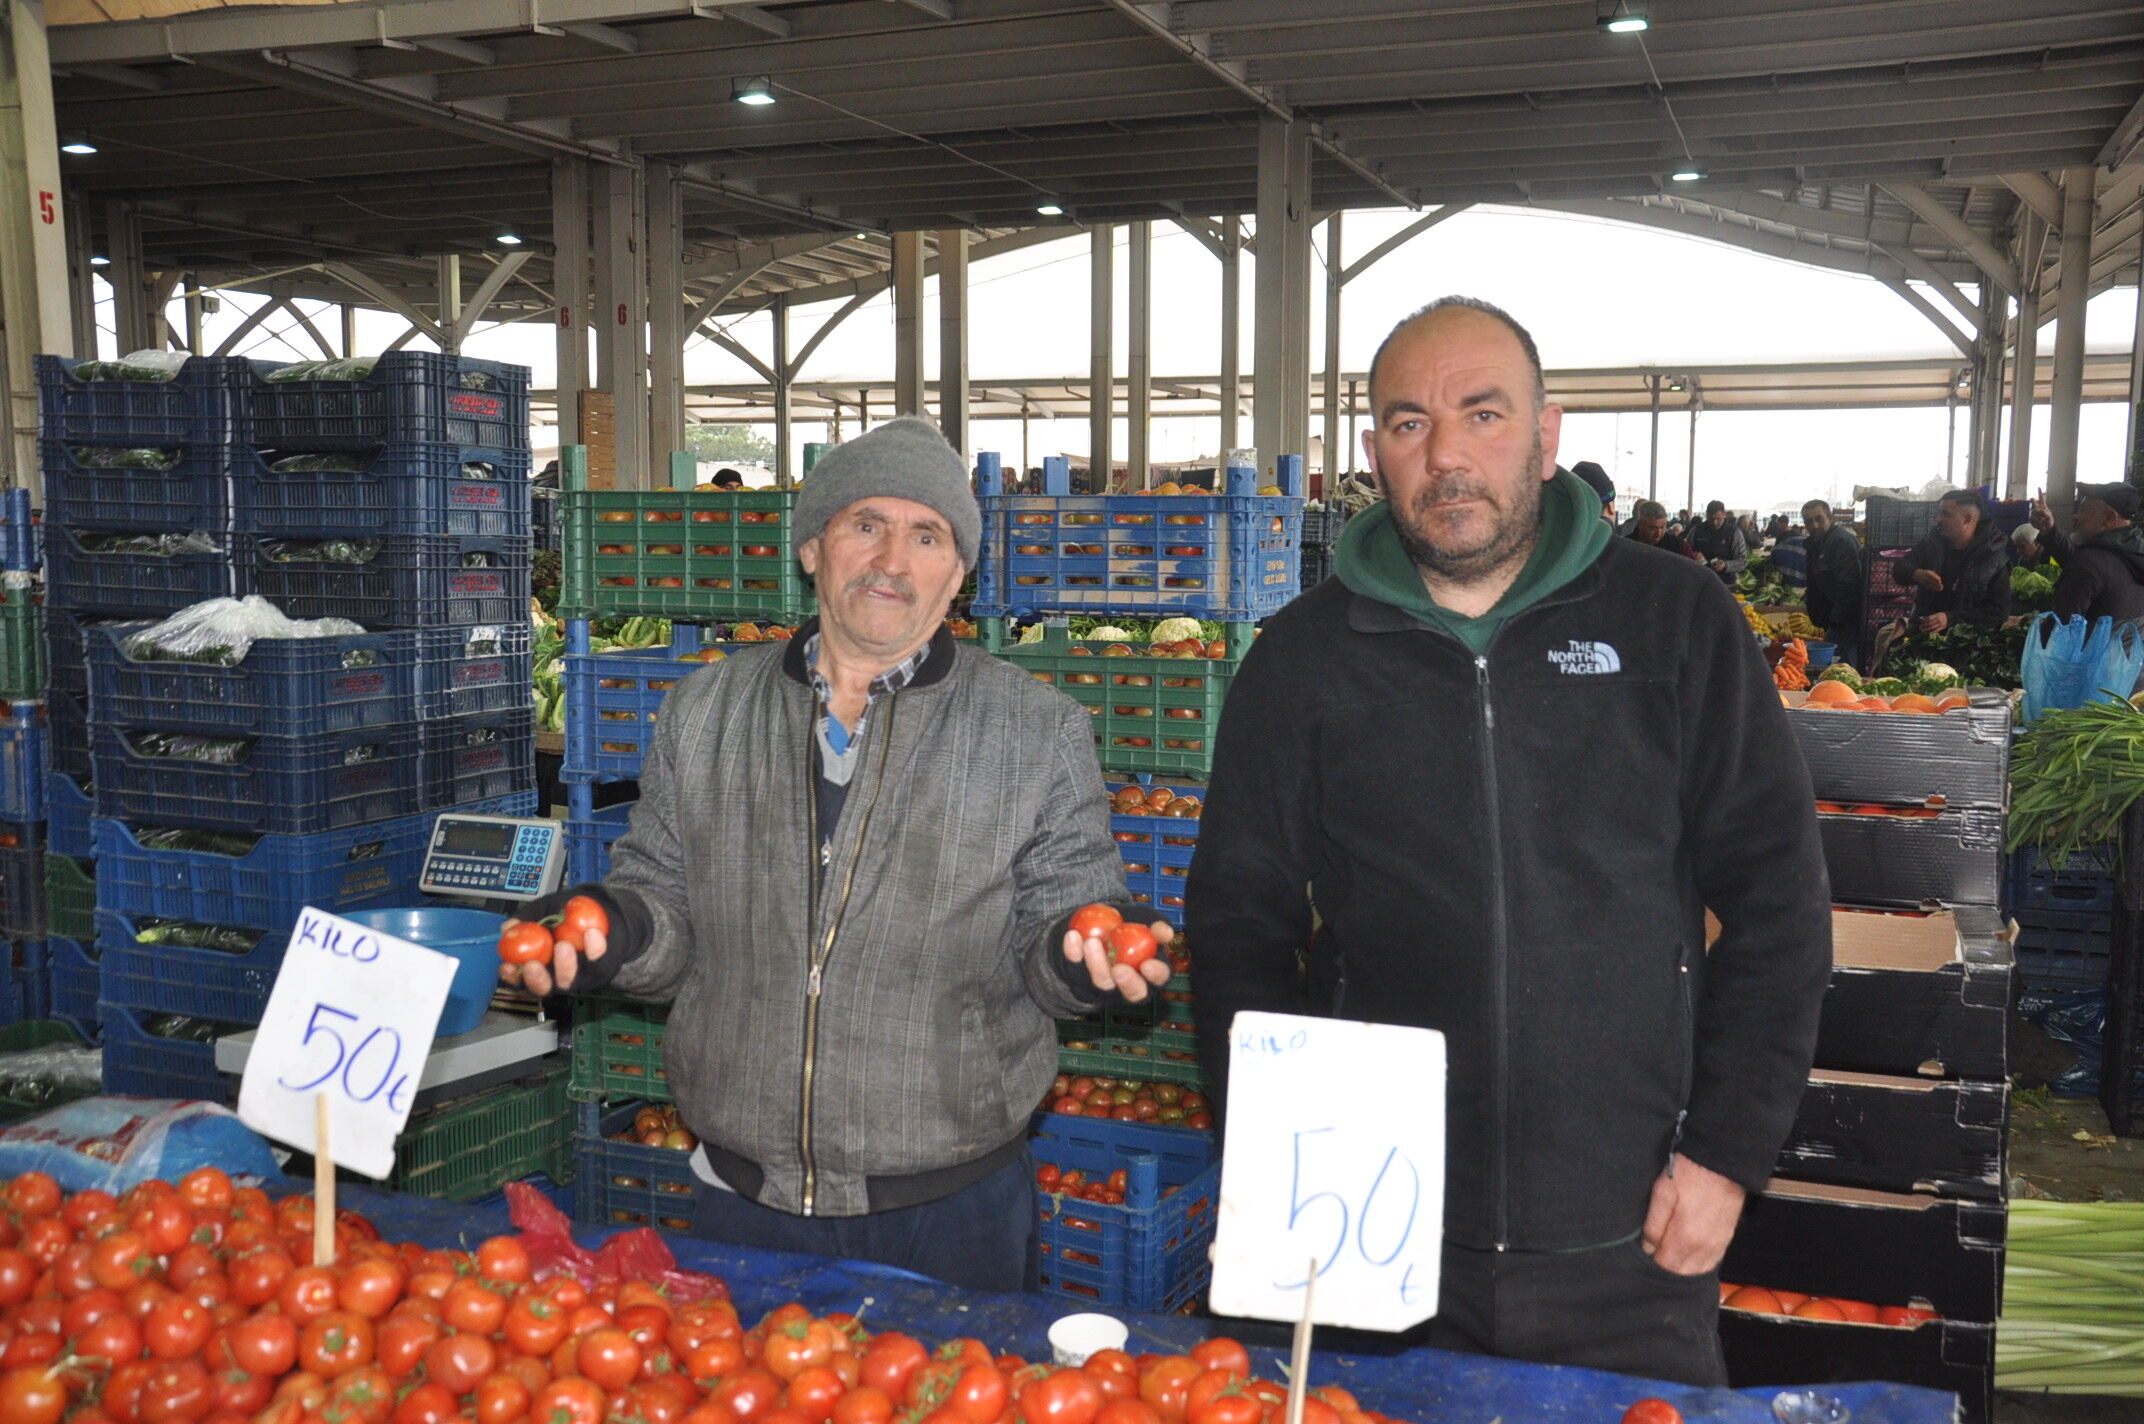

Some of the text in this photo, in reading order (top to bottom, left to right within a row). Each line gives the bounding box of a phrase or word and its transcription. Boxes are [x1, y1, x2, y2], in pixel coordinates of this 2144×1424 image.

[39, 190, 55, 225] 5
[560, 306, 569, 328] 6
[617, 303, 627, 326] 6
[1568, 640, 1592, 652] THE
[1547, 650, 1594, 663] NORTH
[1560, 663, 1594, 675] FACE
